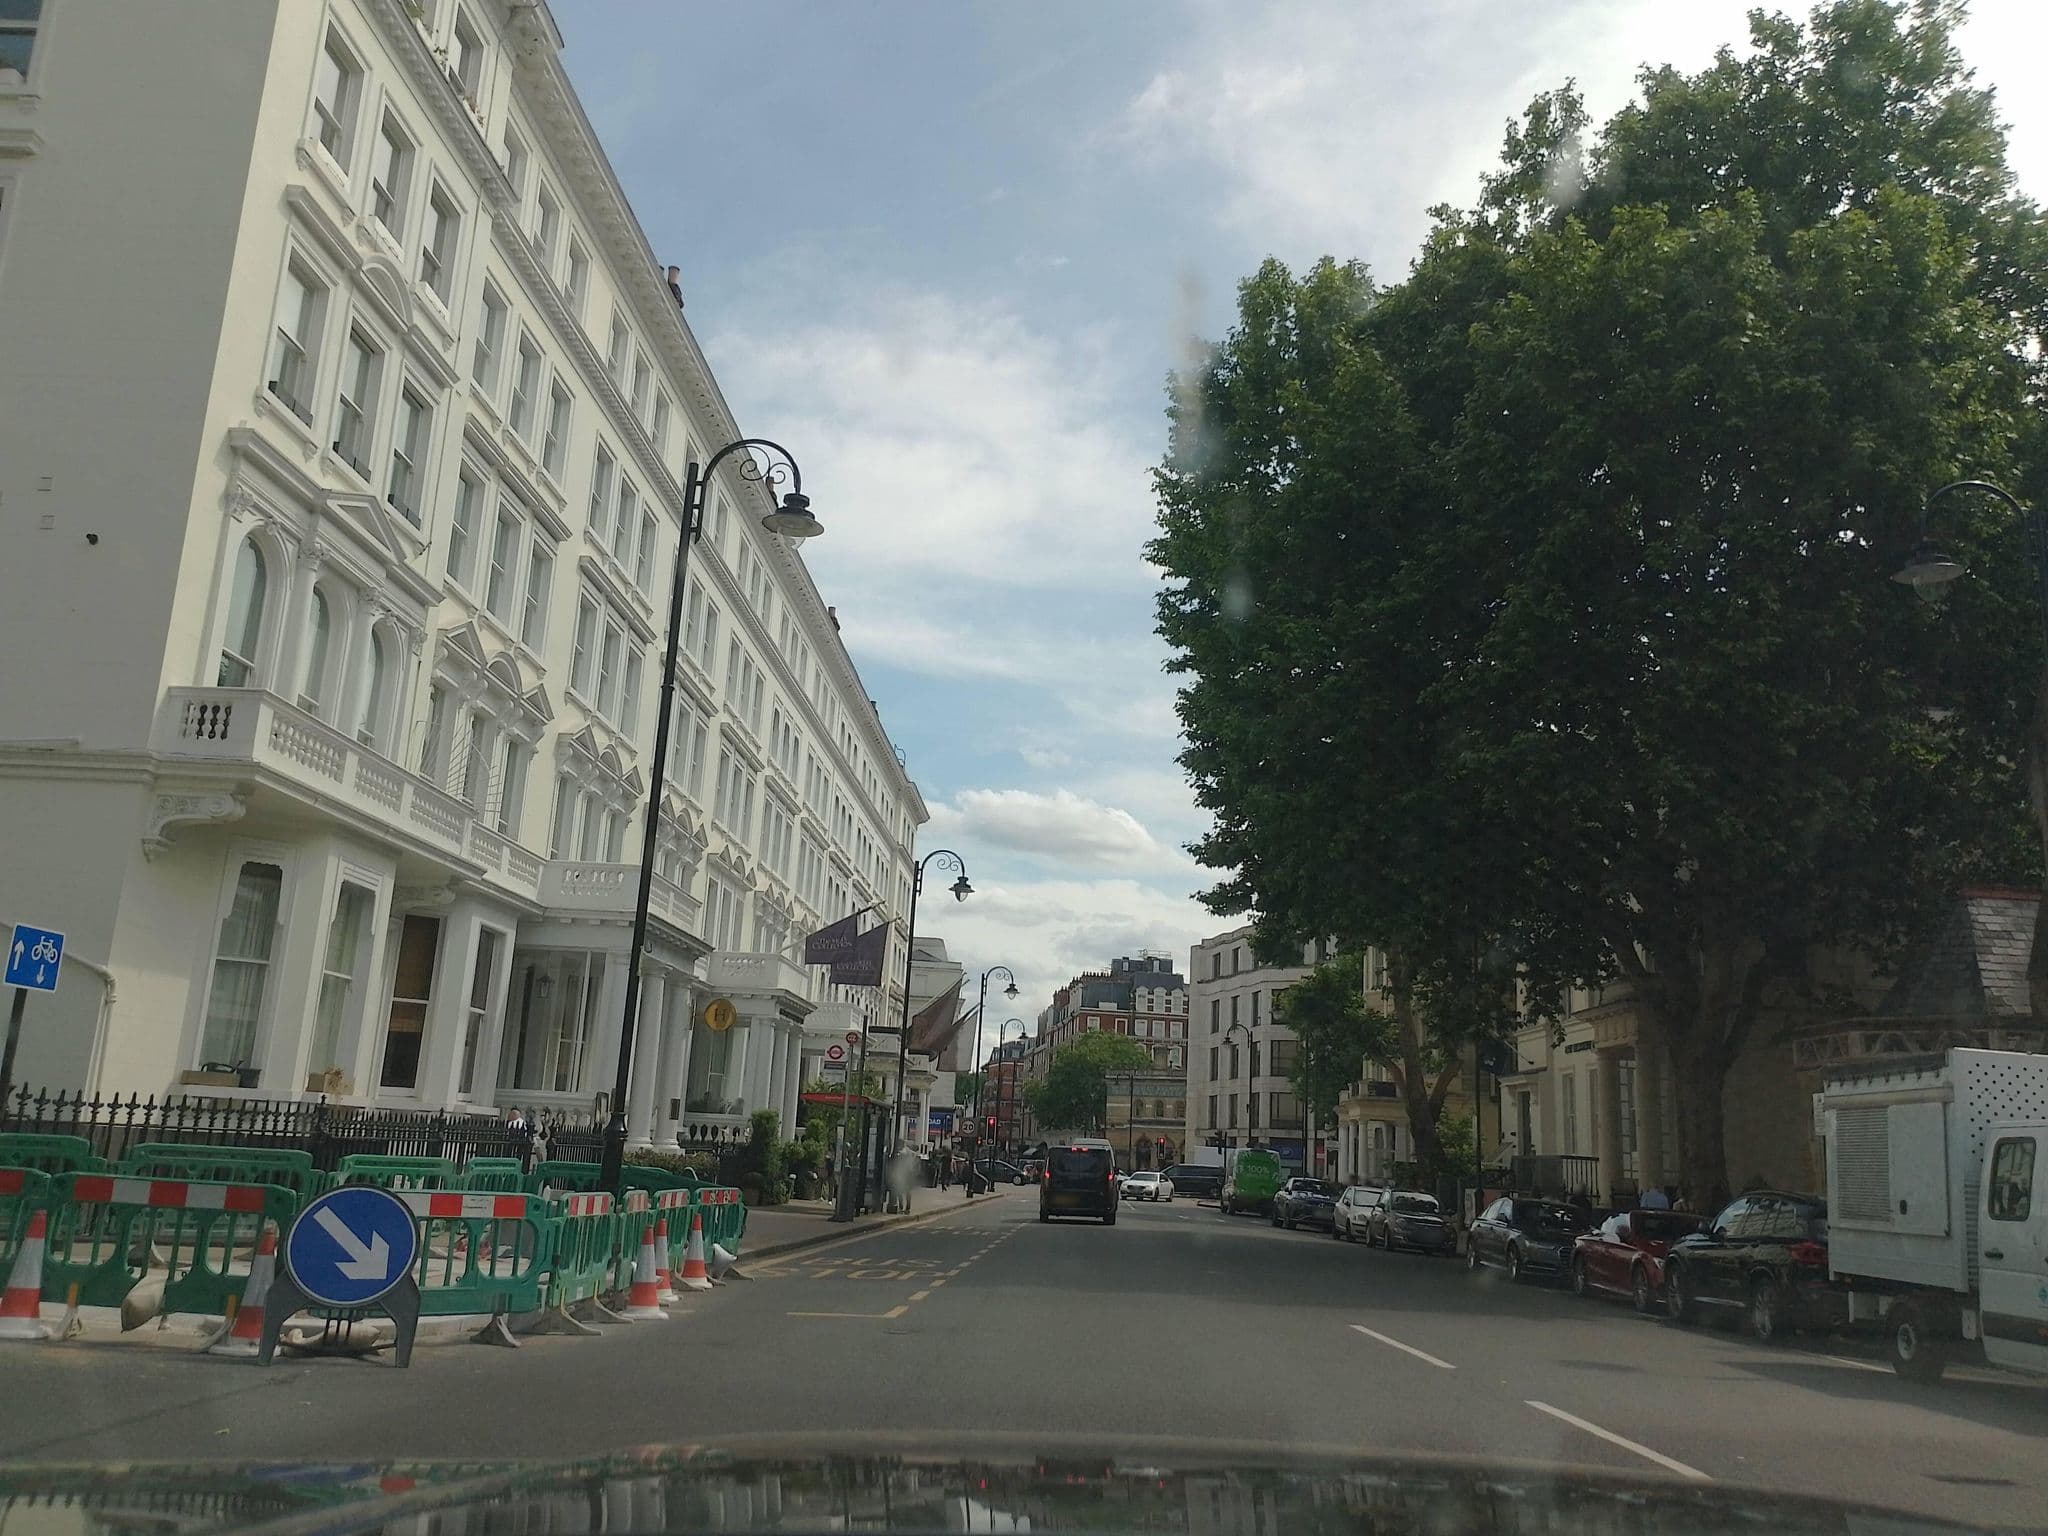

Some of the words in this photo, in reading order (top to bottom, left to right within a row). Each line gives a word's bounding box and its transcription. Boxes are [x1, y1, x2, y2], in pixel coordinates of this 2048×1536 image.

[963, 1123, 974, 1132] 20
[1247, 1164, 1270, 1175] 100%
[801, 1257, 944, 1268] BUS
[755, 1267, 945, 1280] STOP
